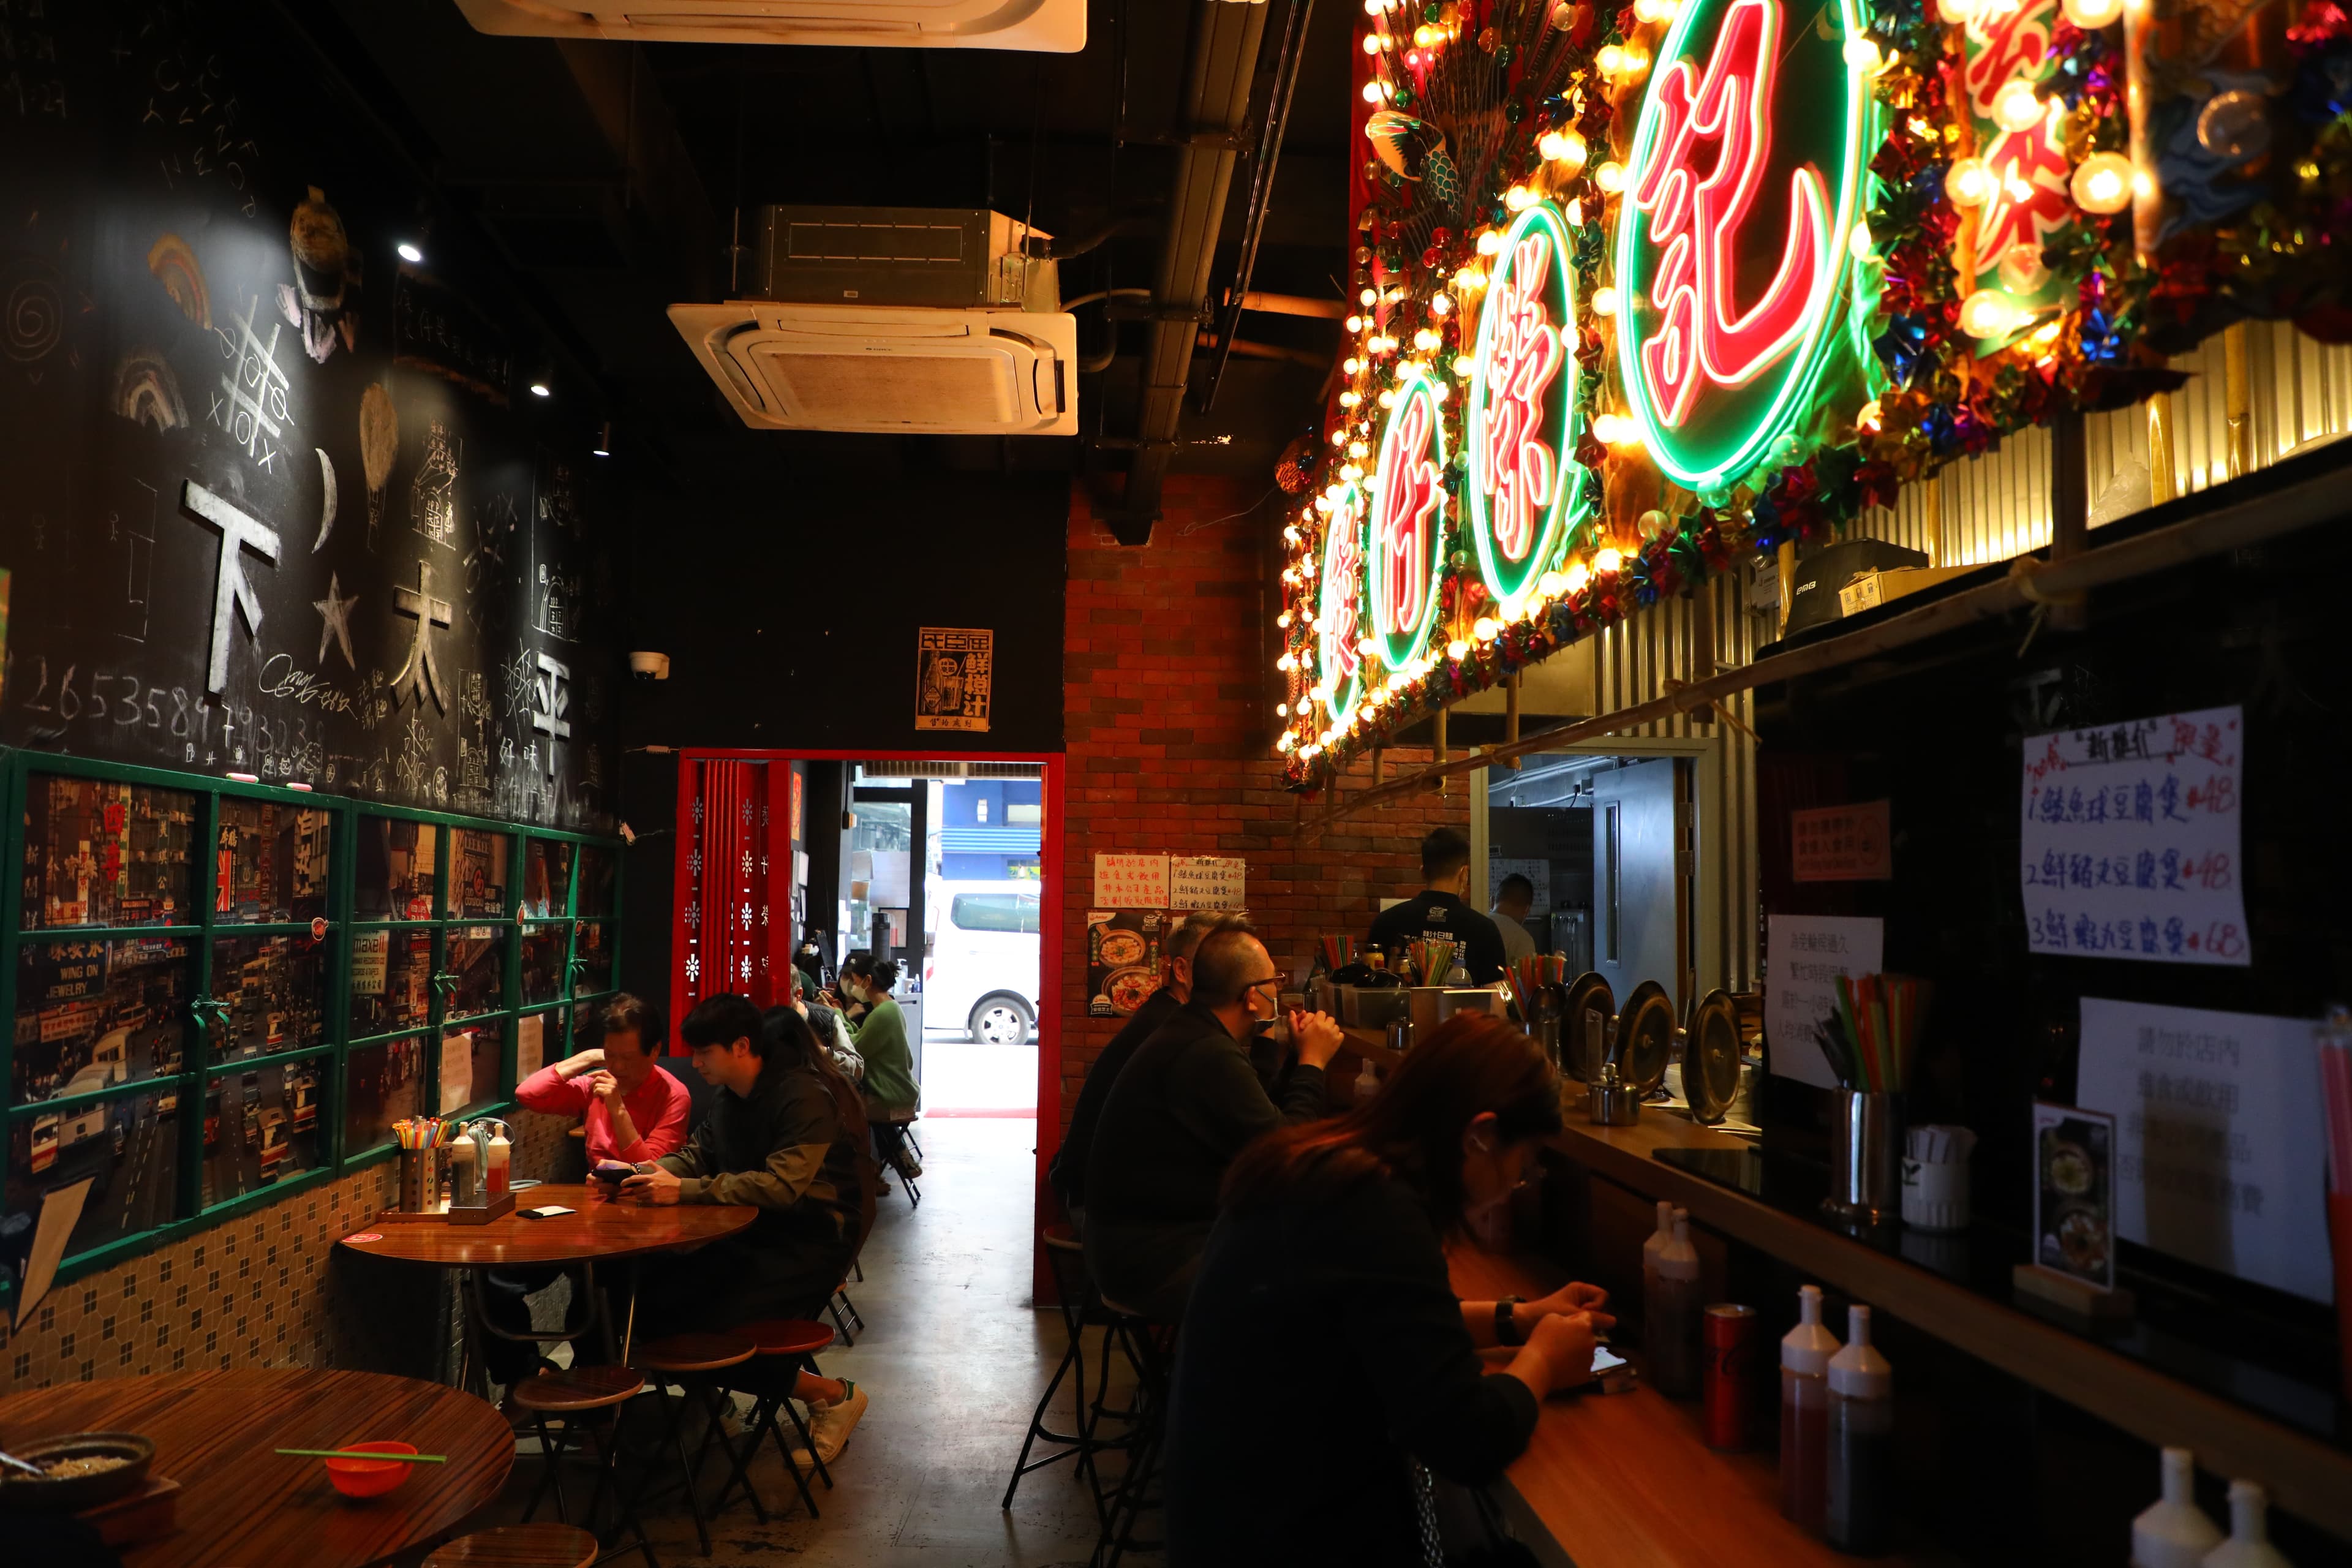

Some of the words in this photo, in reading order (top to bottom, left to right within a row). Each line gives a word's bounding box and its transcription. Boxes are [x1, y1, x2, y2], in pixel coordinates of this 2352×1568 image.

[59, 965, 83, 980] WING
[86, 964, 99, 978] ON
[46, 981, 88, 999] JEWELRY
